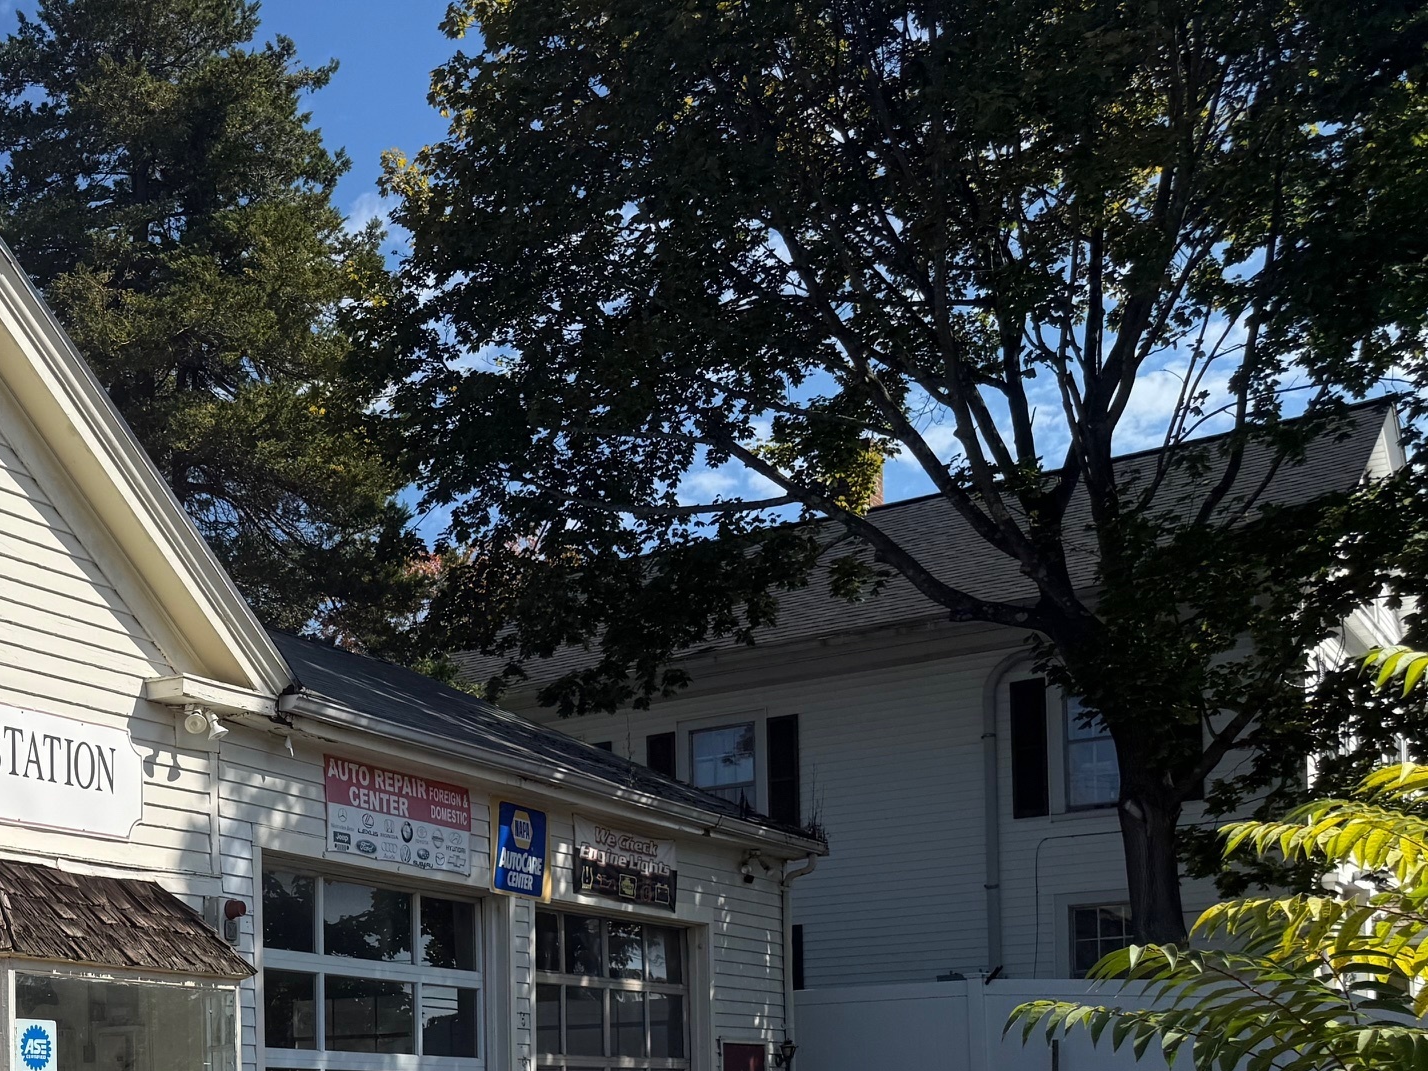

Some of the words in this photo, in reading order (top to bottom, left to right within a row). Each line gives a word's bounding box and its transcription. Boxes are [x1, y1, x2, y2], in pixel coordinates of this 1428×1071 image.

[327, 758, 370, 787] AUTO
[374, 769, 427, 800] REPAIR
[348, 786, 410, 818] CENTER
[429, 787, 462, 807] FOREIGN
[462, 795, 469, 808] &
[430, 805, 468, 826] DOMESTIC
[335, 833, 349, 843] Jeep
[357, 828, 379, 837] LEXUS
[380, 832, 399, 840] HONDA
[514, 819, 531, 840] NAPA
[359, 841, 374, 853] Ford
[445, 845, 466, 854] HYUNDAI
[594, 826, 617, 848] We
[618, 834, 659, 859] Check
[579, 841, 628, 868] Engine
[629, 854, 671, 877] Lights
[507, 871, 533, 891] CENTER
[24, 1038, 47, 1055] ASE
